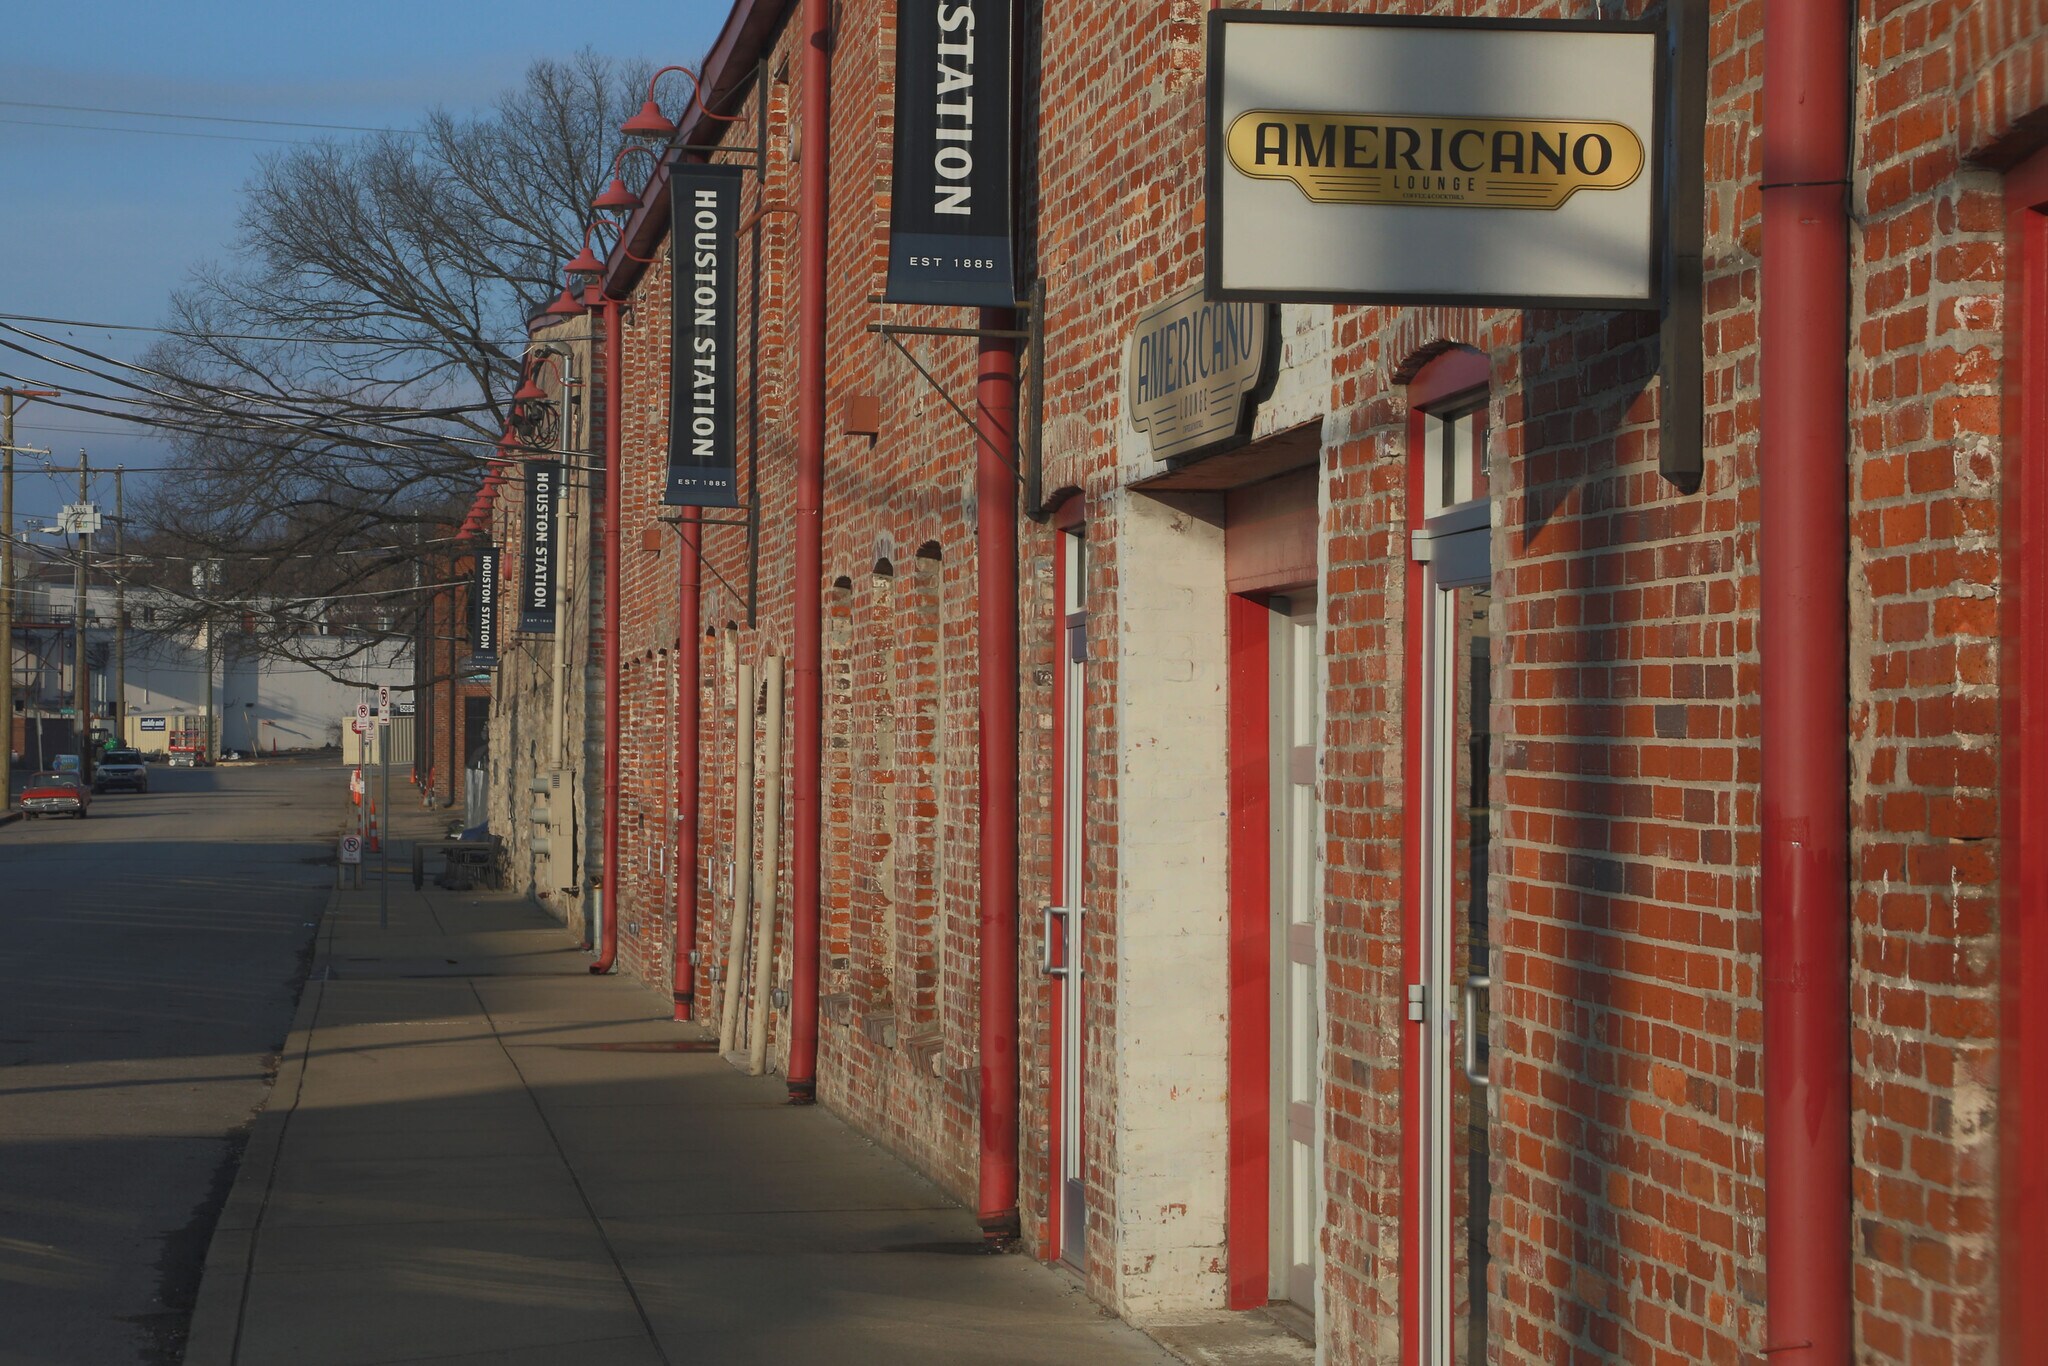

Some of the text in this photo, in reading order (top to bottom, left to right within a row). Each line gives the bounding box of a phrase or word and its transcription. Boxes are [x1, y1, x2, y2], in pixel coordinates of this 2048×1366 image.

[935, 4, 976, 215] STATION
[1254, 121, 1613, 176] AMERICANO
[1393, 174, 1476, 192] LOUNGE
[909, 256, 994, 269] EST 1885
[692, 190, 718, 456] HOUSTON STATION
[1137, 302, 1253, 405] AMERICANO
[534, 472, 549, 608] HOUSTON STATION
[481, 555, 492, 604] HOUSTON
[480, 606, 490, 649] STATION
